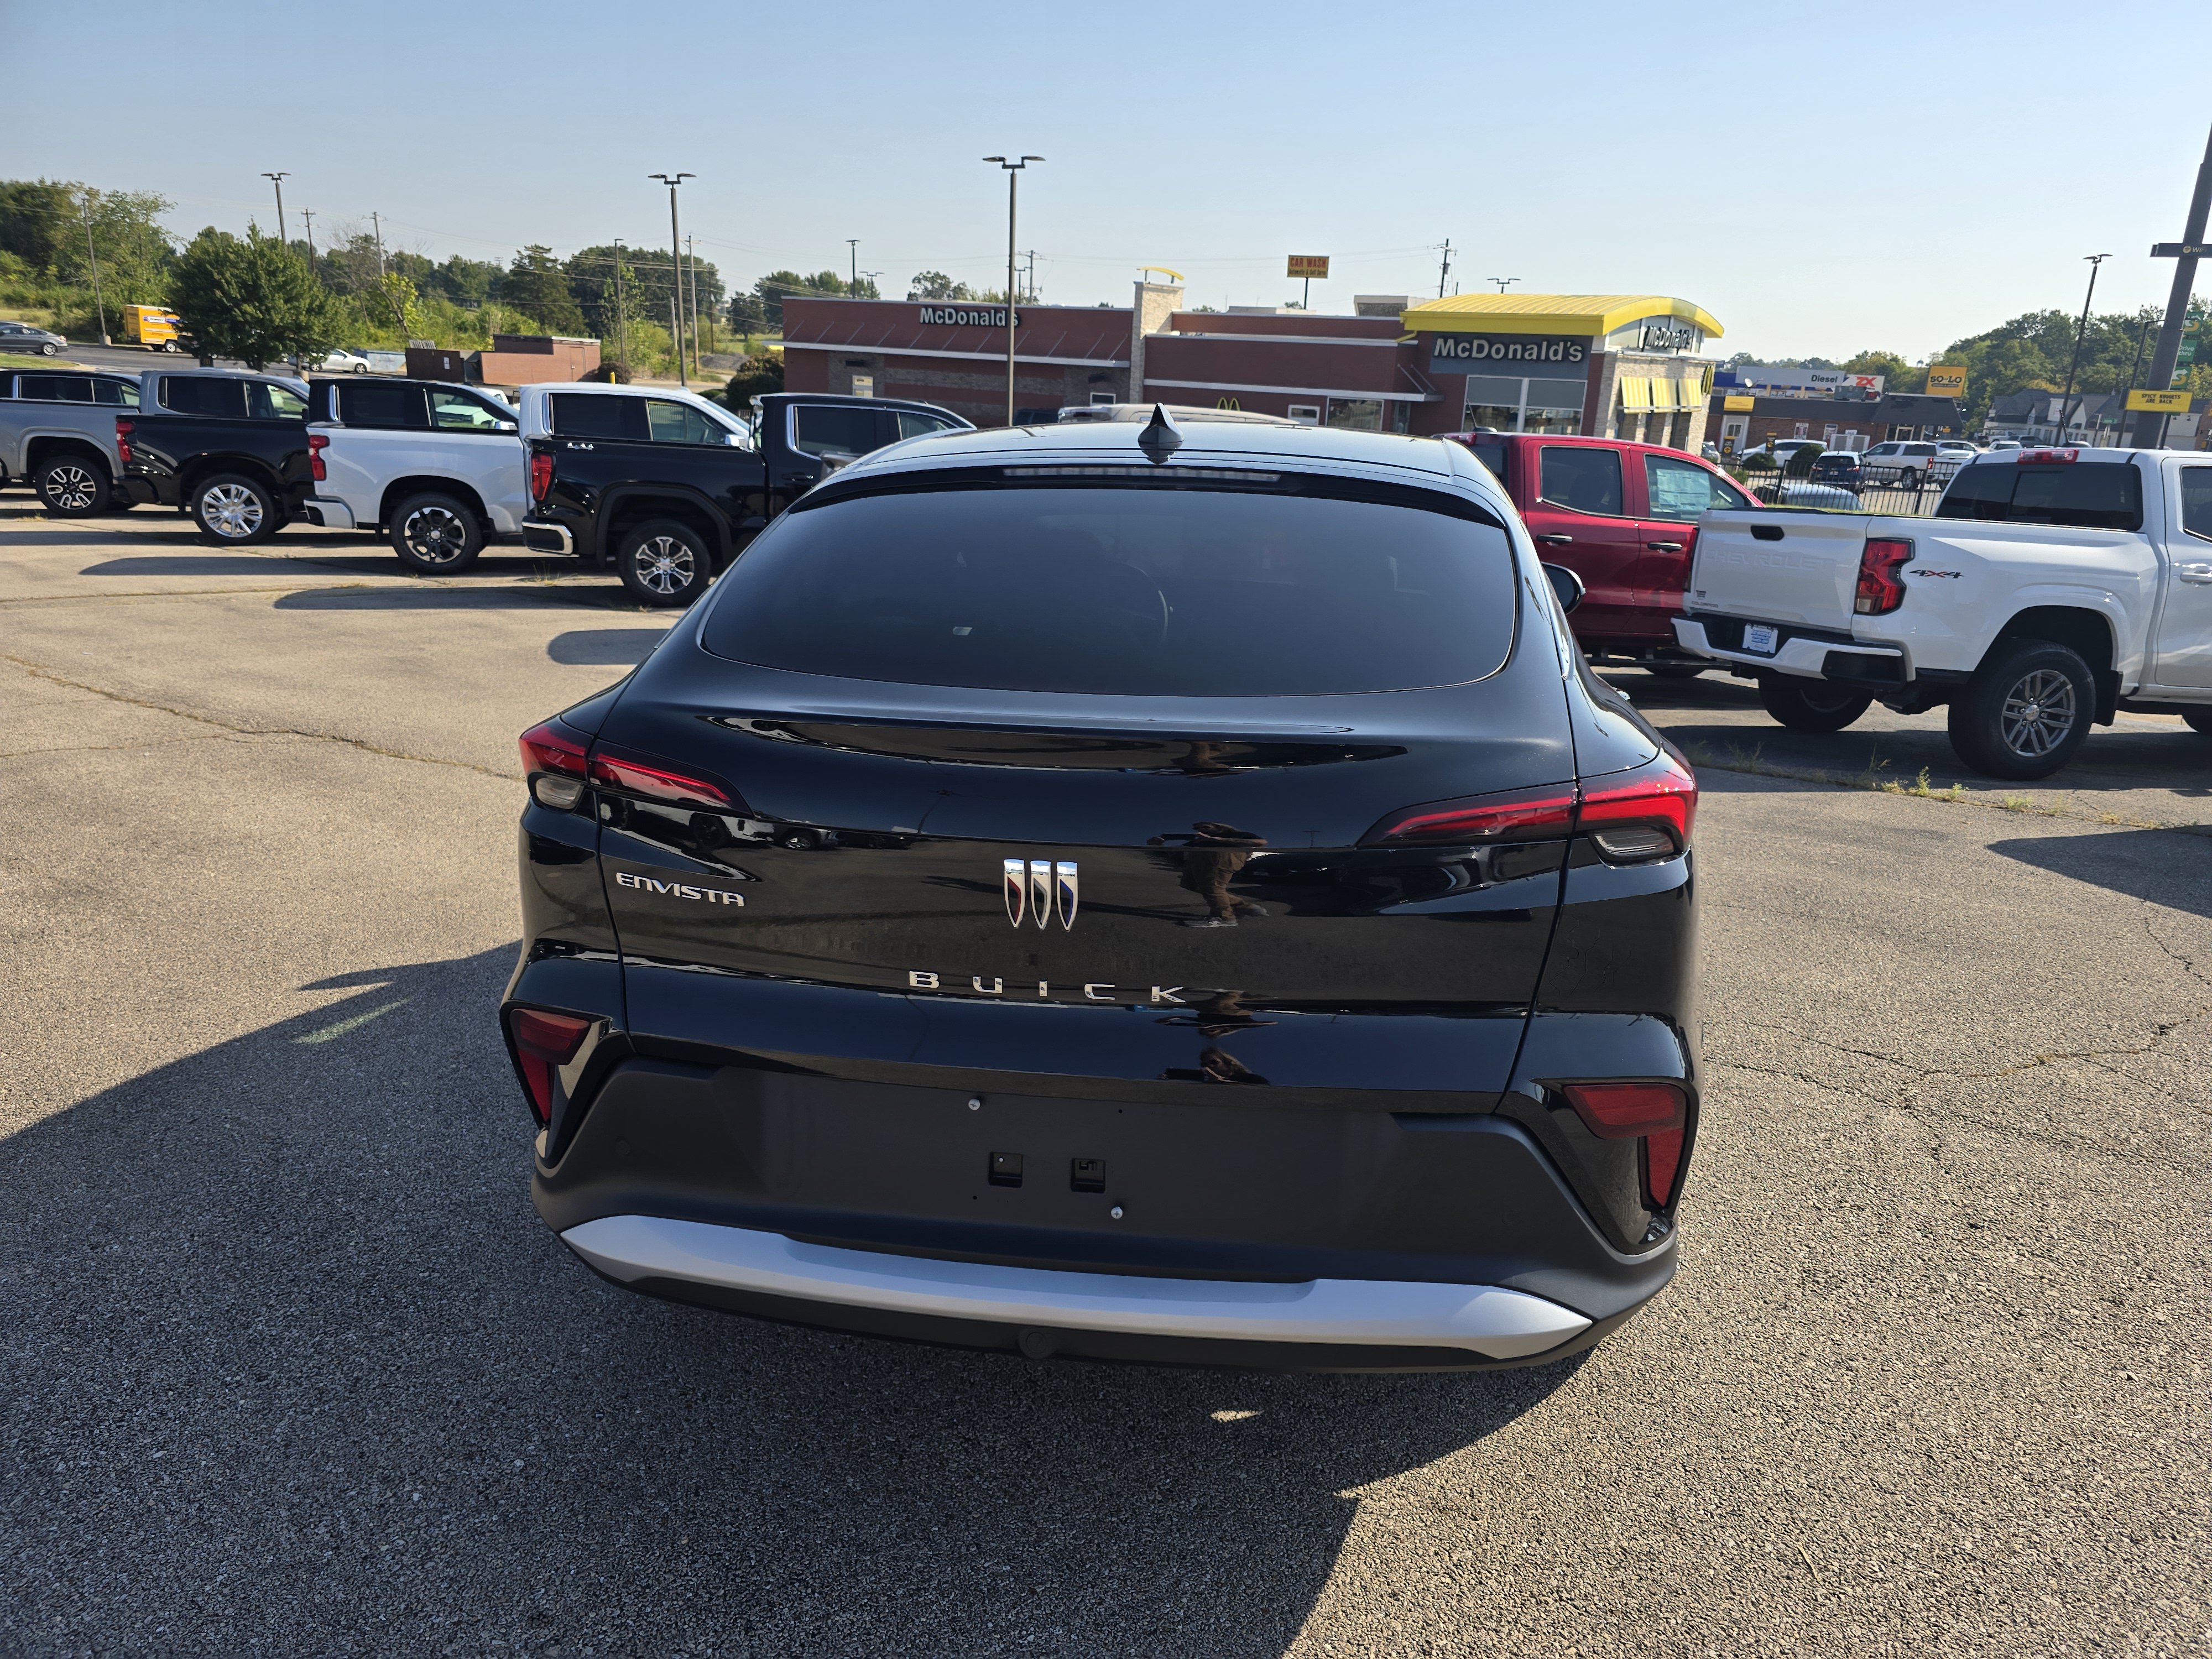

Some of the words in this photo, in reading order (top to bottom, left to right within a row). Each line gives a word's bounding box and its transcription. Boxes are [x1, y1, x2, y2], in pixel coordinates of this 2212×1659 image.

[1290, 257, 1303, 268] CAR
[1306, 258, 1327, 268] WASH
[1646, 326, 1692, 348] McDonald's
[1434, 338, 1582, 362] McDonald's
[1811, 374, 1838, 383] Diesel
[615, 872, 745, 907] ENVISTA
[909, 971, 1186, 1003] BUICK
